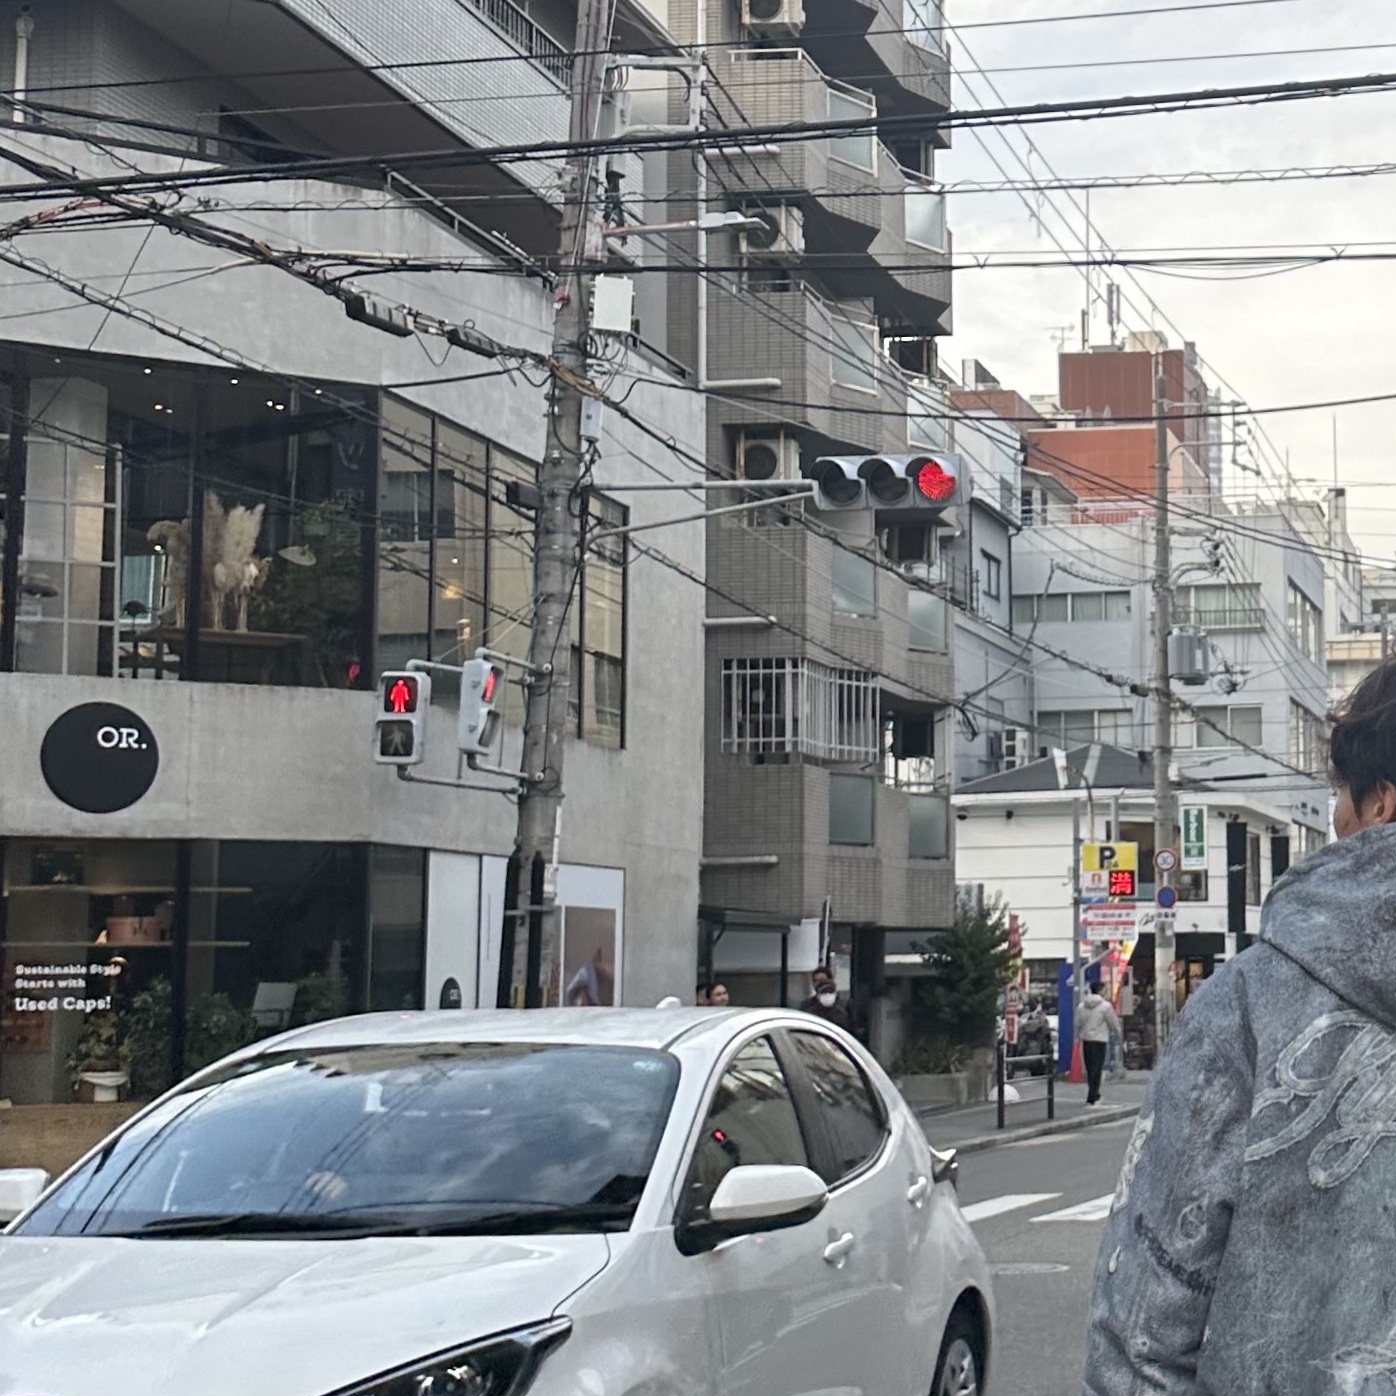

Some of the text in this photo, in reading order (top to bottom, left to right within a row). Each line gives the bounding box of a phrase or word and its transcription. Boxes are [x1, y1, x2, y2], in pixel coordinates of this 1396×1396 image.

[97, 726, 147, 749] OR.
[1099, 846, 1116, 869] P
[1110, 871, 1133, 895] 満
[15, 964, 88, 975] Sustainable
[15, 978, 86, 989] Starts with
[15, 995, 112, 1013] Used Caps!
